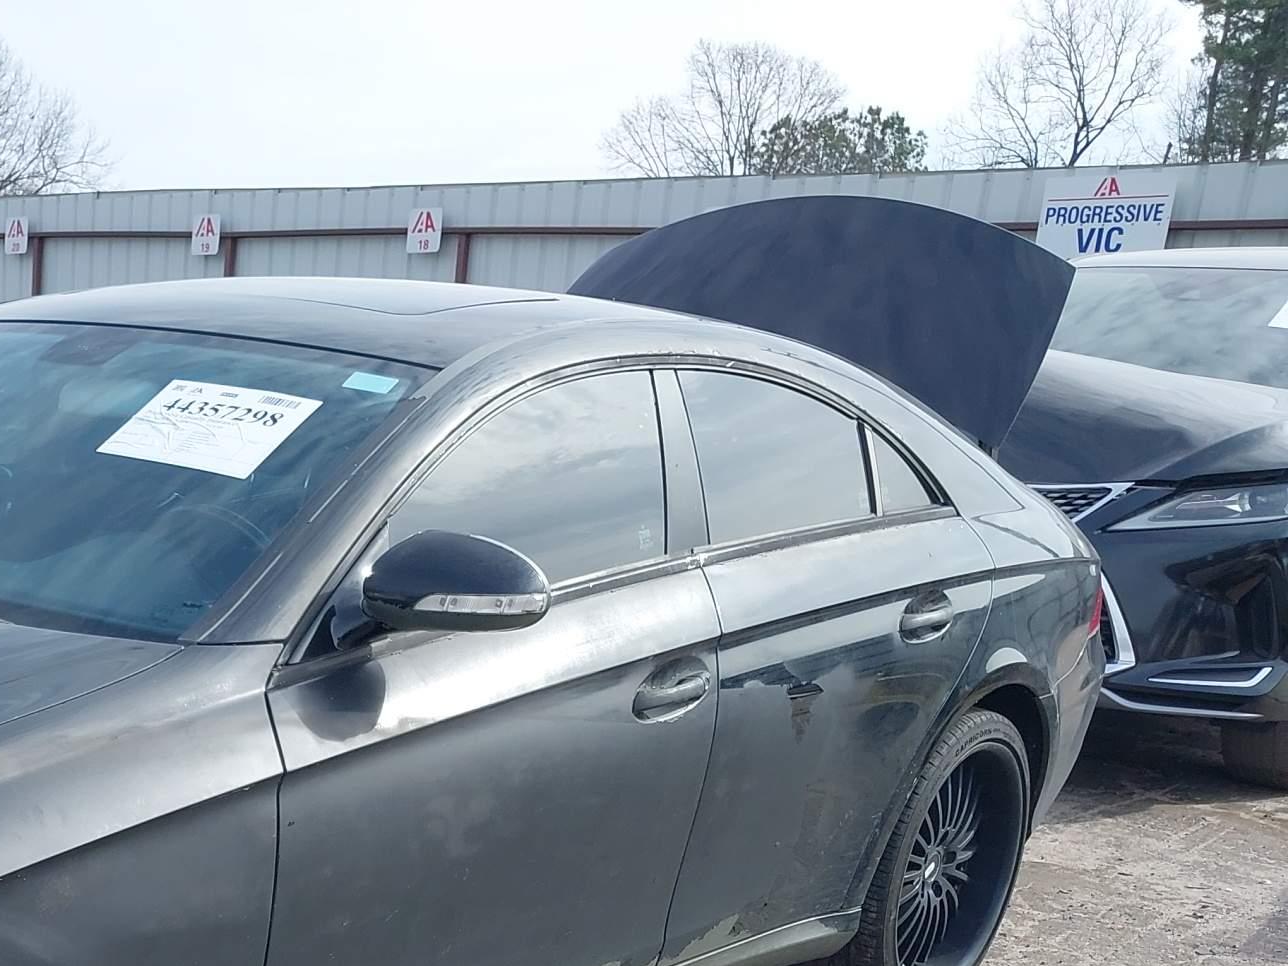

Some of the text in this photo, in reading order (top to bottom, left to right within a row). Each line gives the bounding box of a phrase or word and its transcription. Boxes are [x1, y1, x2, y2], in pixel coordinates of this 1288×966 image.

[1045, 203, 1166, 225] PROGRESSIVE
[418, 239, 430, 250] 18
[1077, 226, 1124, 254] VIC
[162, 397, 285, 428] 44357298
[954, 727, 993, 757] CAPRICORN
